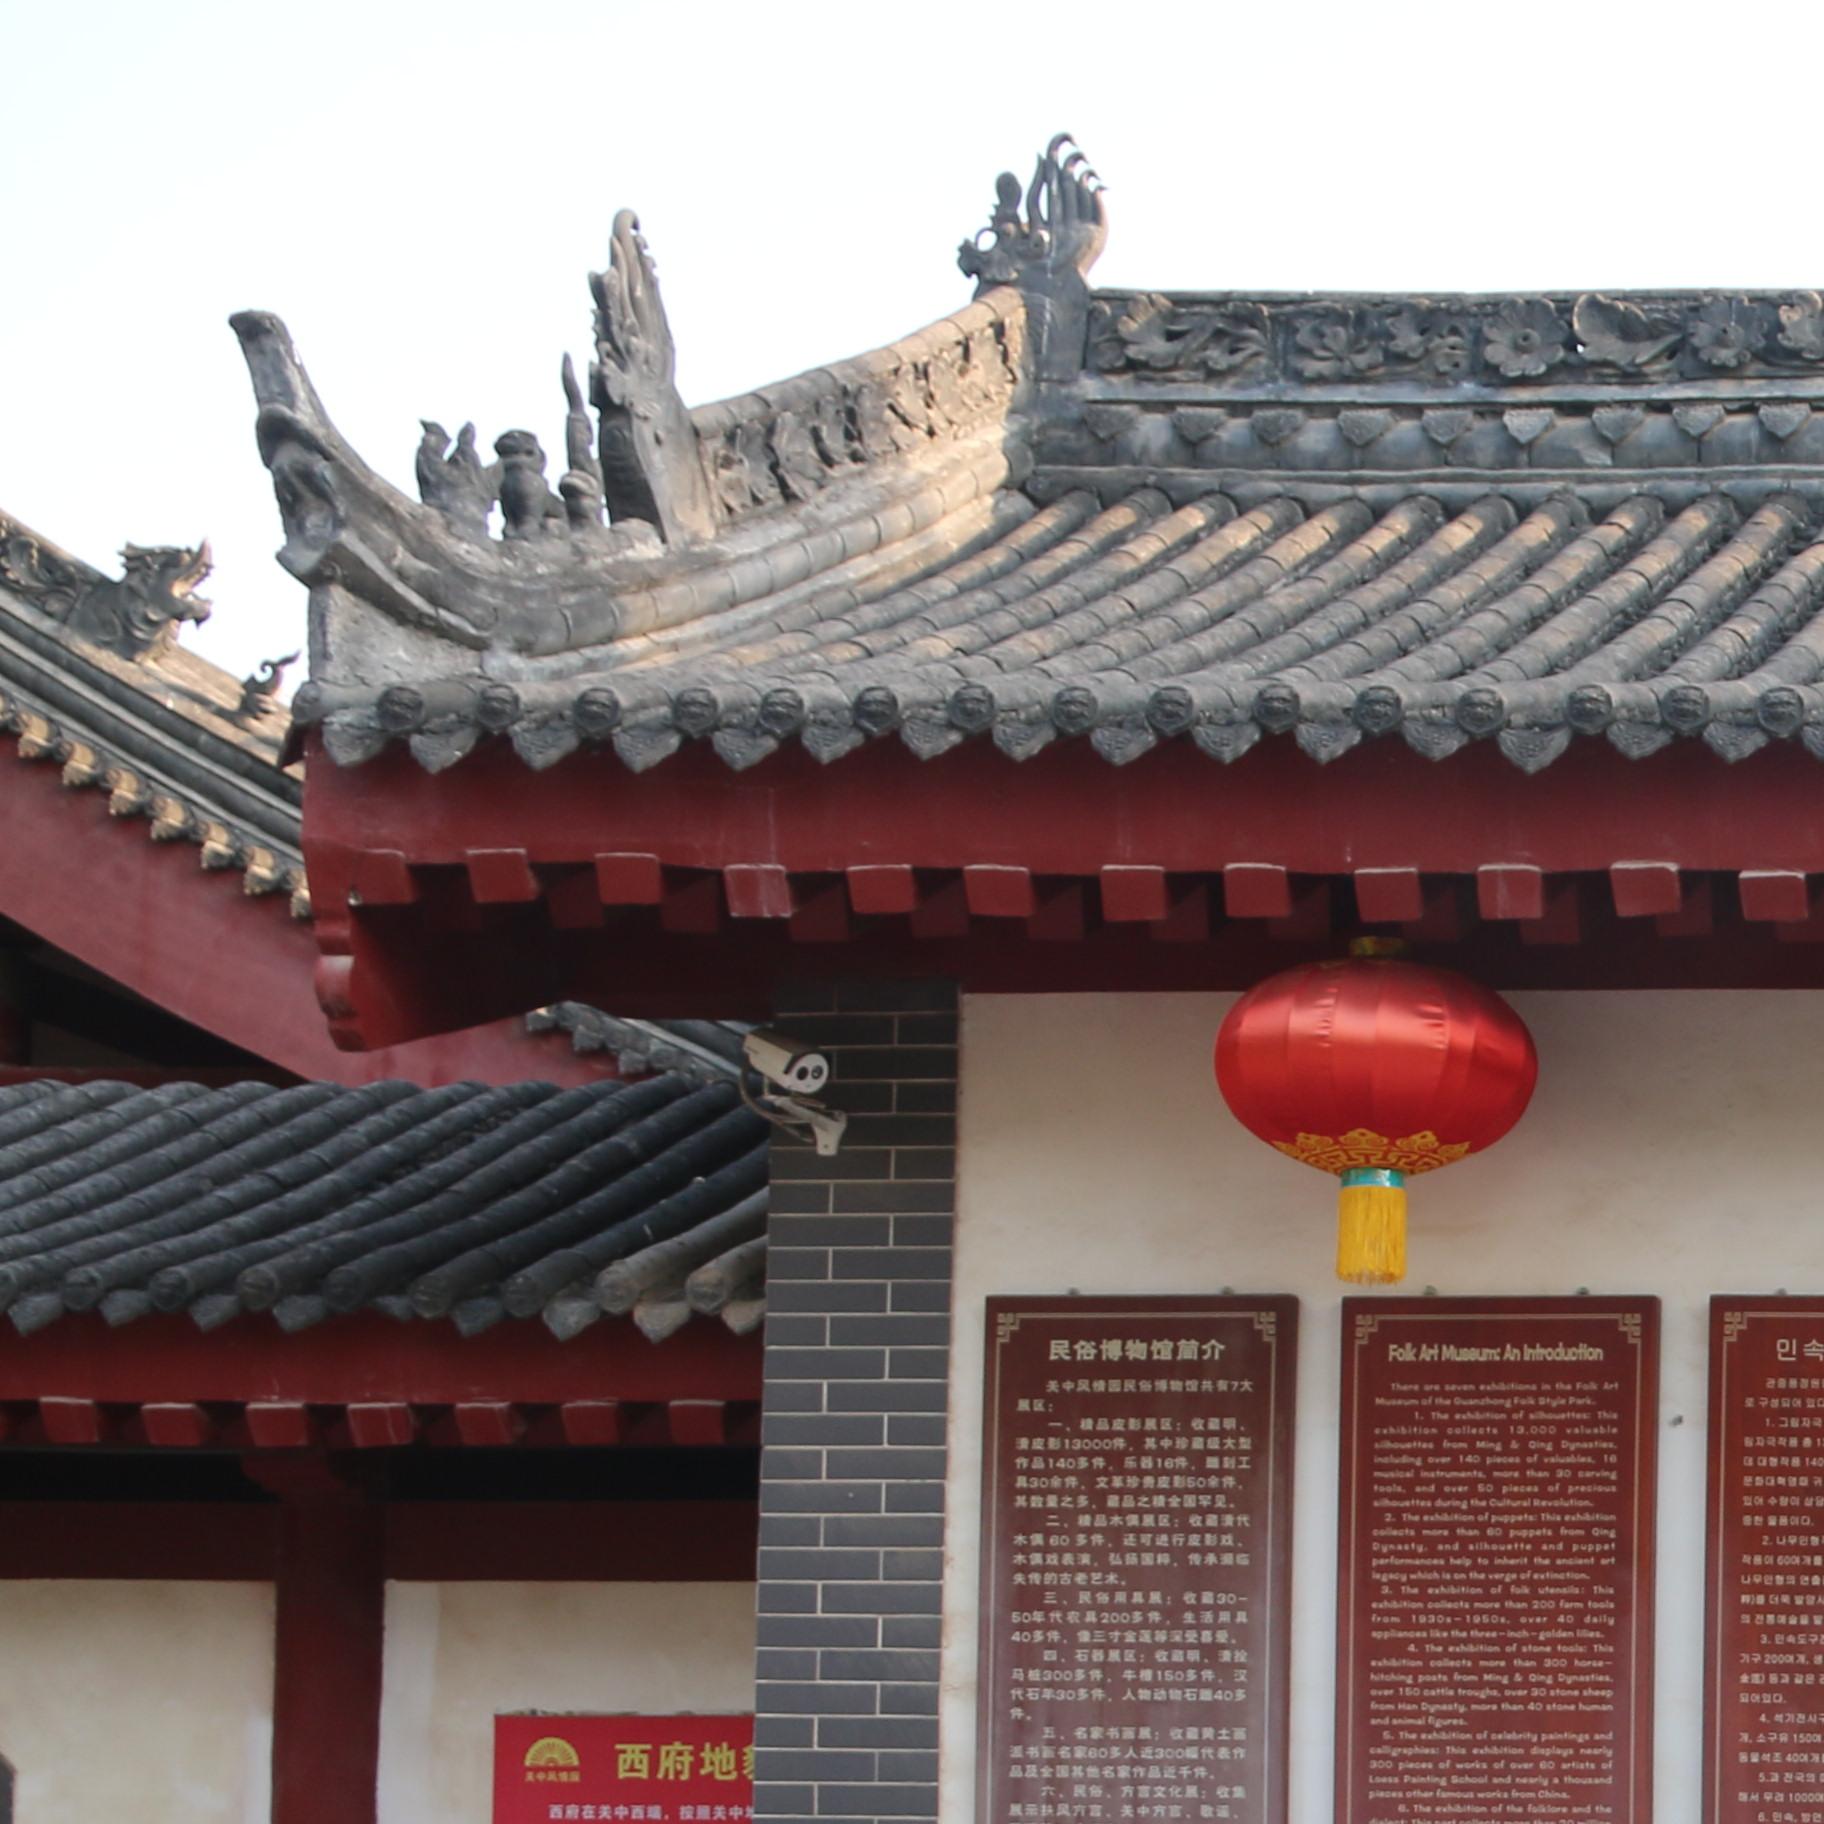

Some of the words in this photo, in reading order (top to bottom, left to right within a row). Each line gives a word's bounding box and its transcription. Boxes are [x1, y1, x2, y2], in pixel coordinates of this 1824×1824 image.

[1049, 1339, 1226, 1361] 民俗博物馆简介
